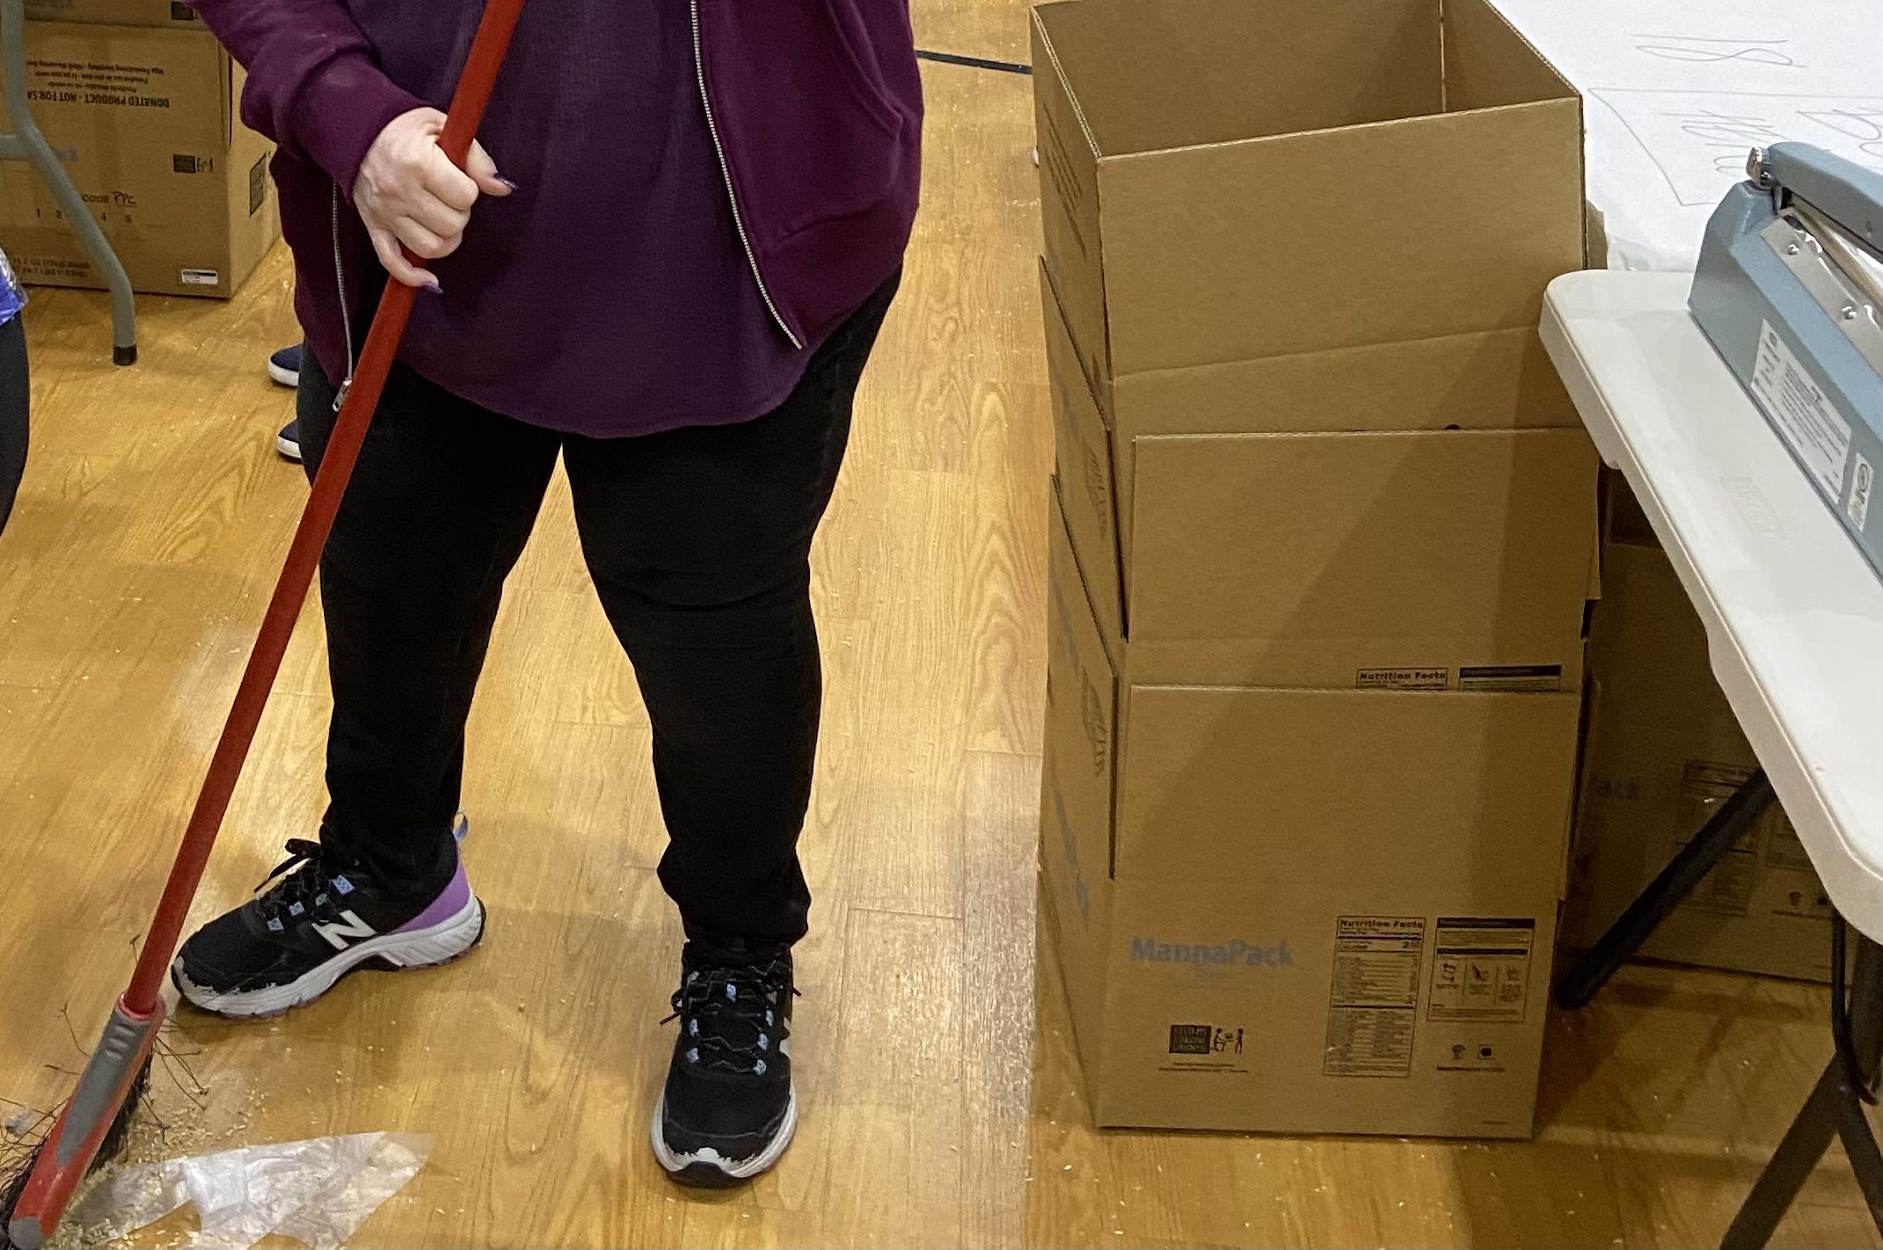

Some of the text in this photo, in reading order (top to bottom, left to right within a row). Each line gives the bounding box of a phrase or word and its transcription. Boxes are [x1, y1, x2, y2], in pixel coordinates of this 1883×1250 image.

[59, 91, 77, 102] NOT
[85, 94, 126, 106] PRODUCT
[128, 96, 170, 108] DONATED
[1359, 671, 1446, 680] Nutrition Facts
[1129, 936, 1294, 966] MannaPack
